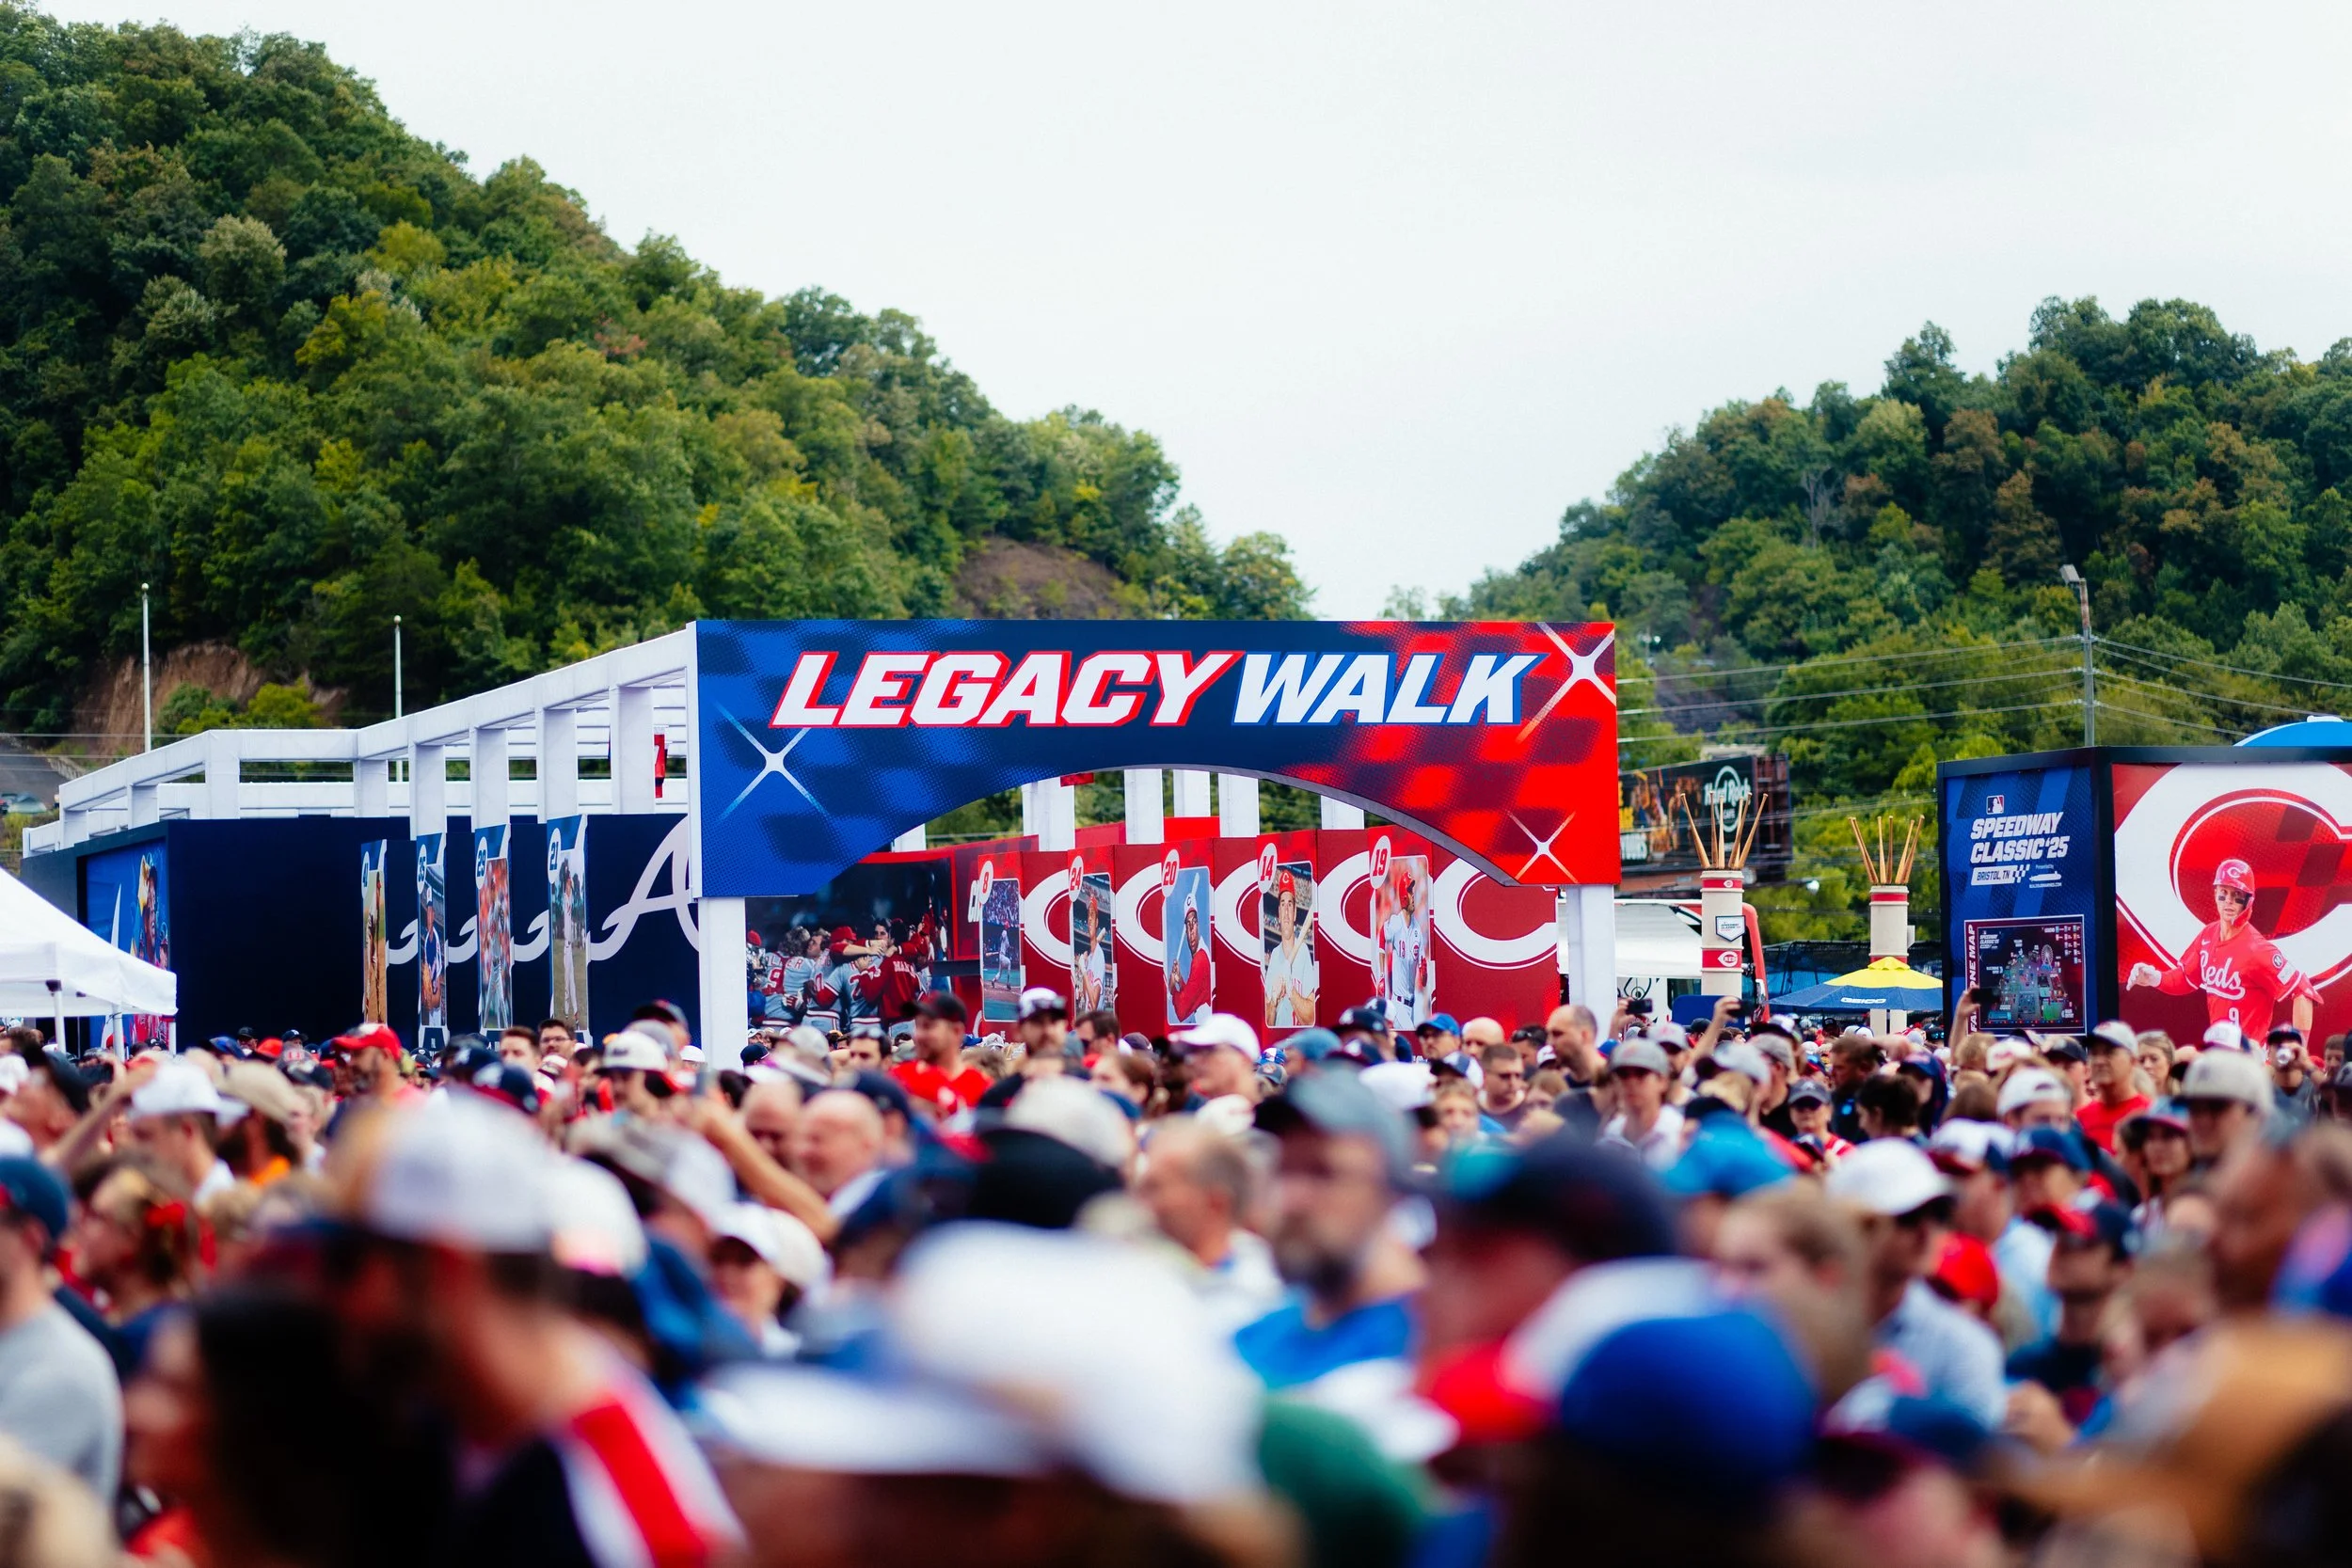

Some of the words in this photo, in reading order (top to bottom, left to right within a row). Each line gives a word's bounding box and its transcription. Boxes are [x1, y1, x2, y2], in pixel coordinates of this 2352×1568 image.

[770, 651, 1244, 728] LEGACY
[1232, 651, 1548, 727] WALK
[1970, 812, 2064, 840] SPEEDWAY
[549, 841, 559, 871] 21
[1372, 847, 1388, 877] 19
[1970, 837, 2045, 863] CLASSIC
[1069, 866, 1082, 892] 24
[1163, 861, 1177, 886] 20
[1260, 855, 1275, 881] 14
[1977, 871, 2001, 881] BRISTOL,
[2002, 870, 2010, 879] TN
[981, 871, 990, 895] 8
[2199, 950, 2246, 1000] Reds
